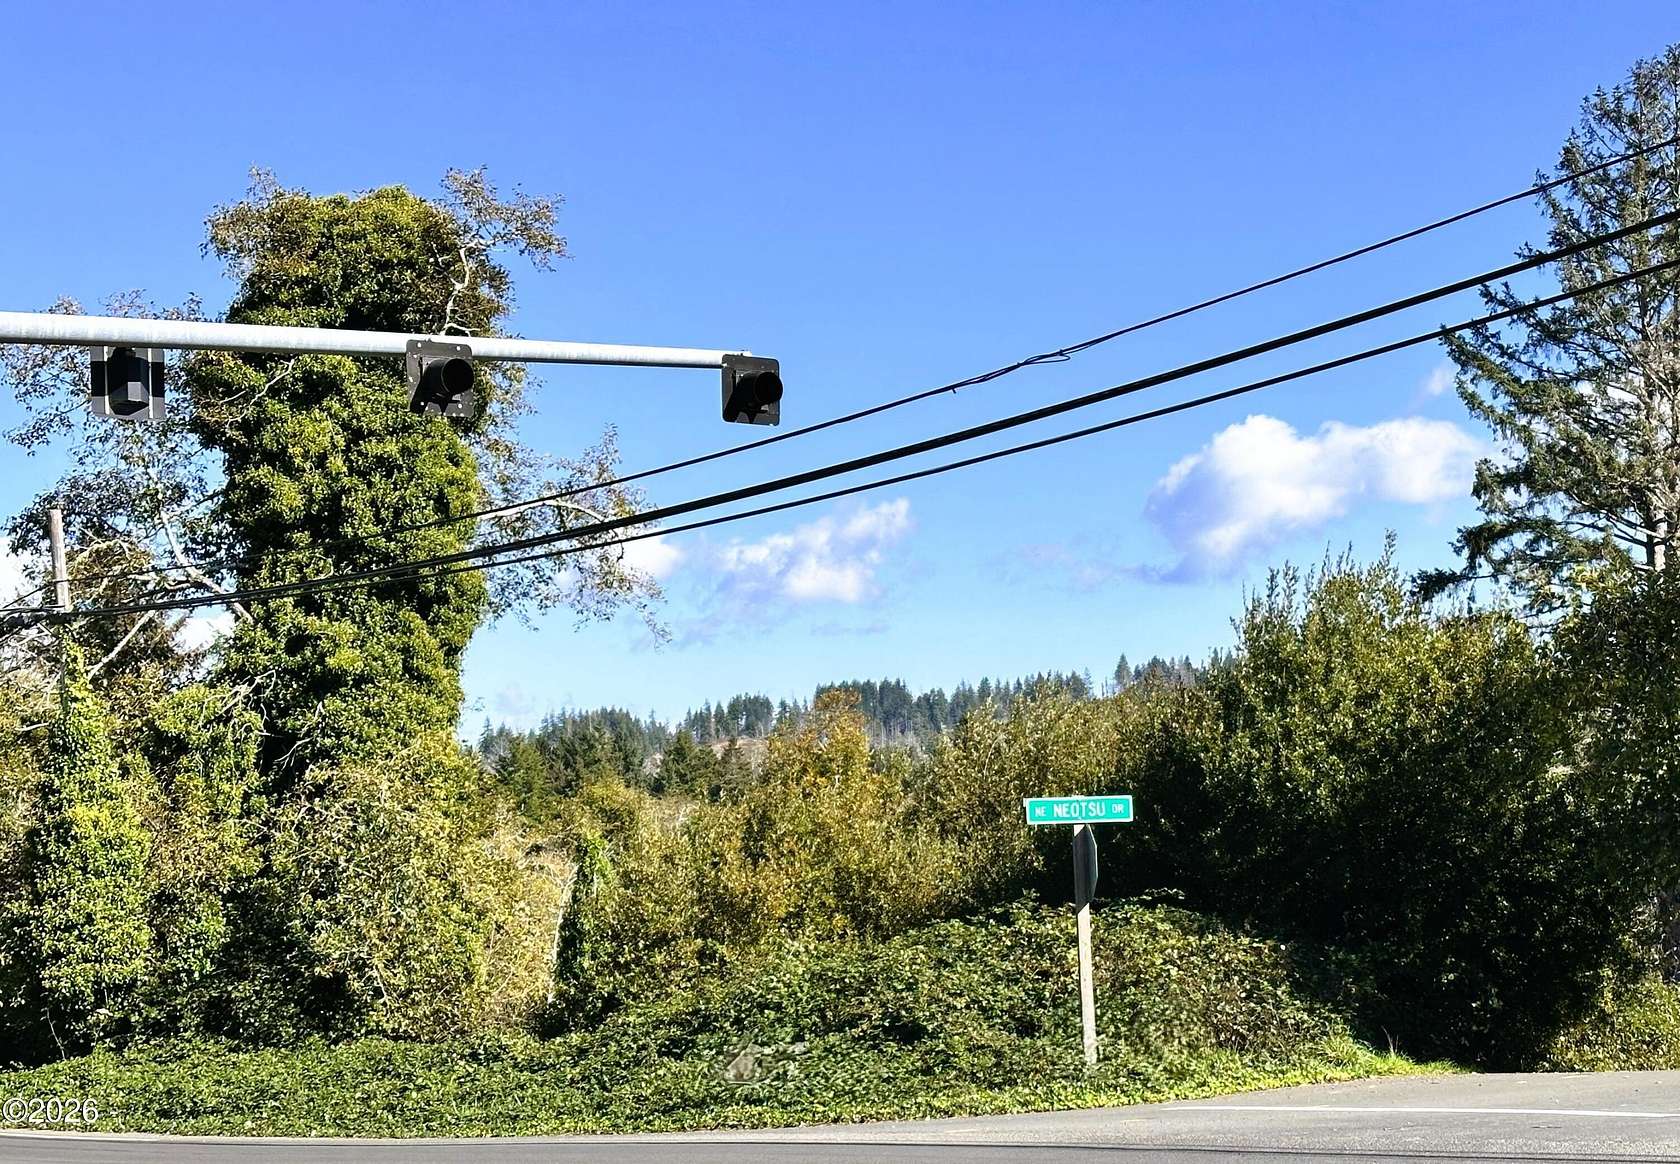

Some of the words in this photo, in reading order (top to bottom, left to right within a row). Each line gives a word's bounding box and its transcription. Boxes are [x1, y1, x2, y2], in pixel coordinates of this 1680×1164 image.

[1035, 806, 1047, 817] NE
[1053, 802, 1106, 818] NEOTSU
[1111, 803, 1125, 814] DR
